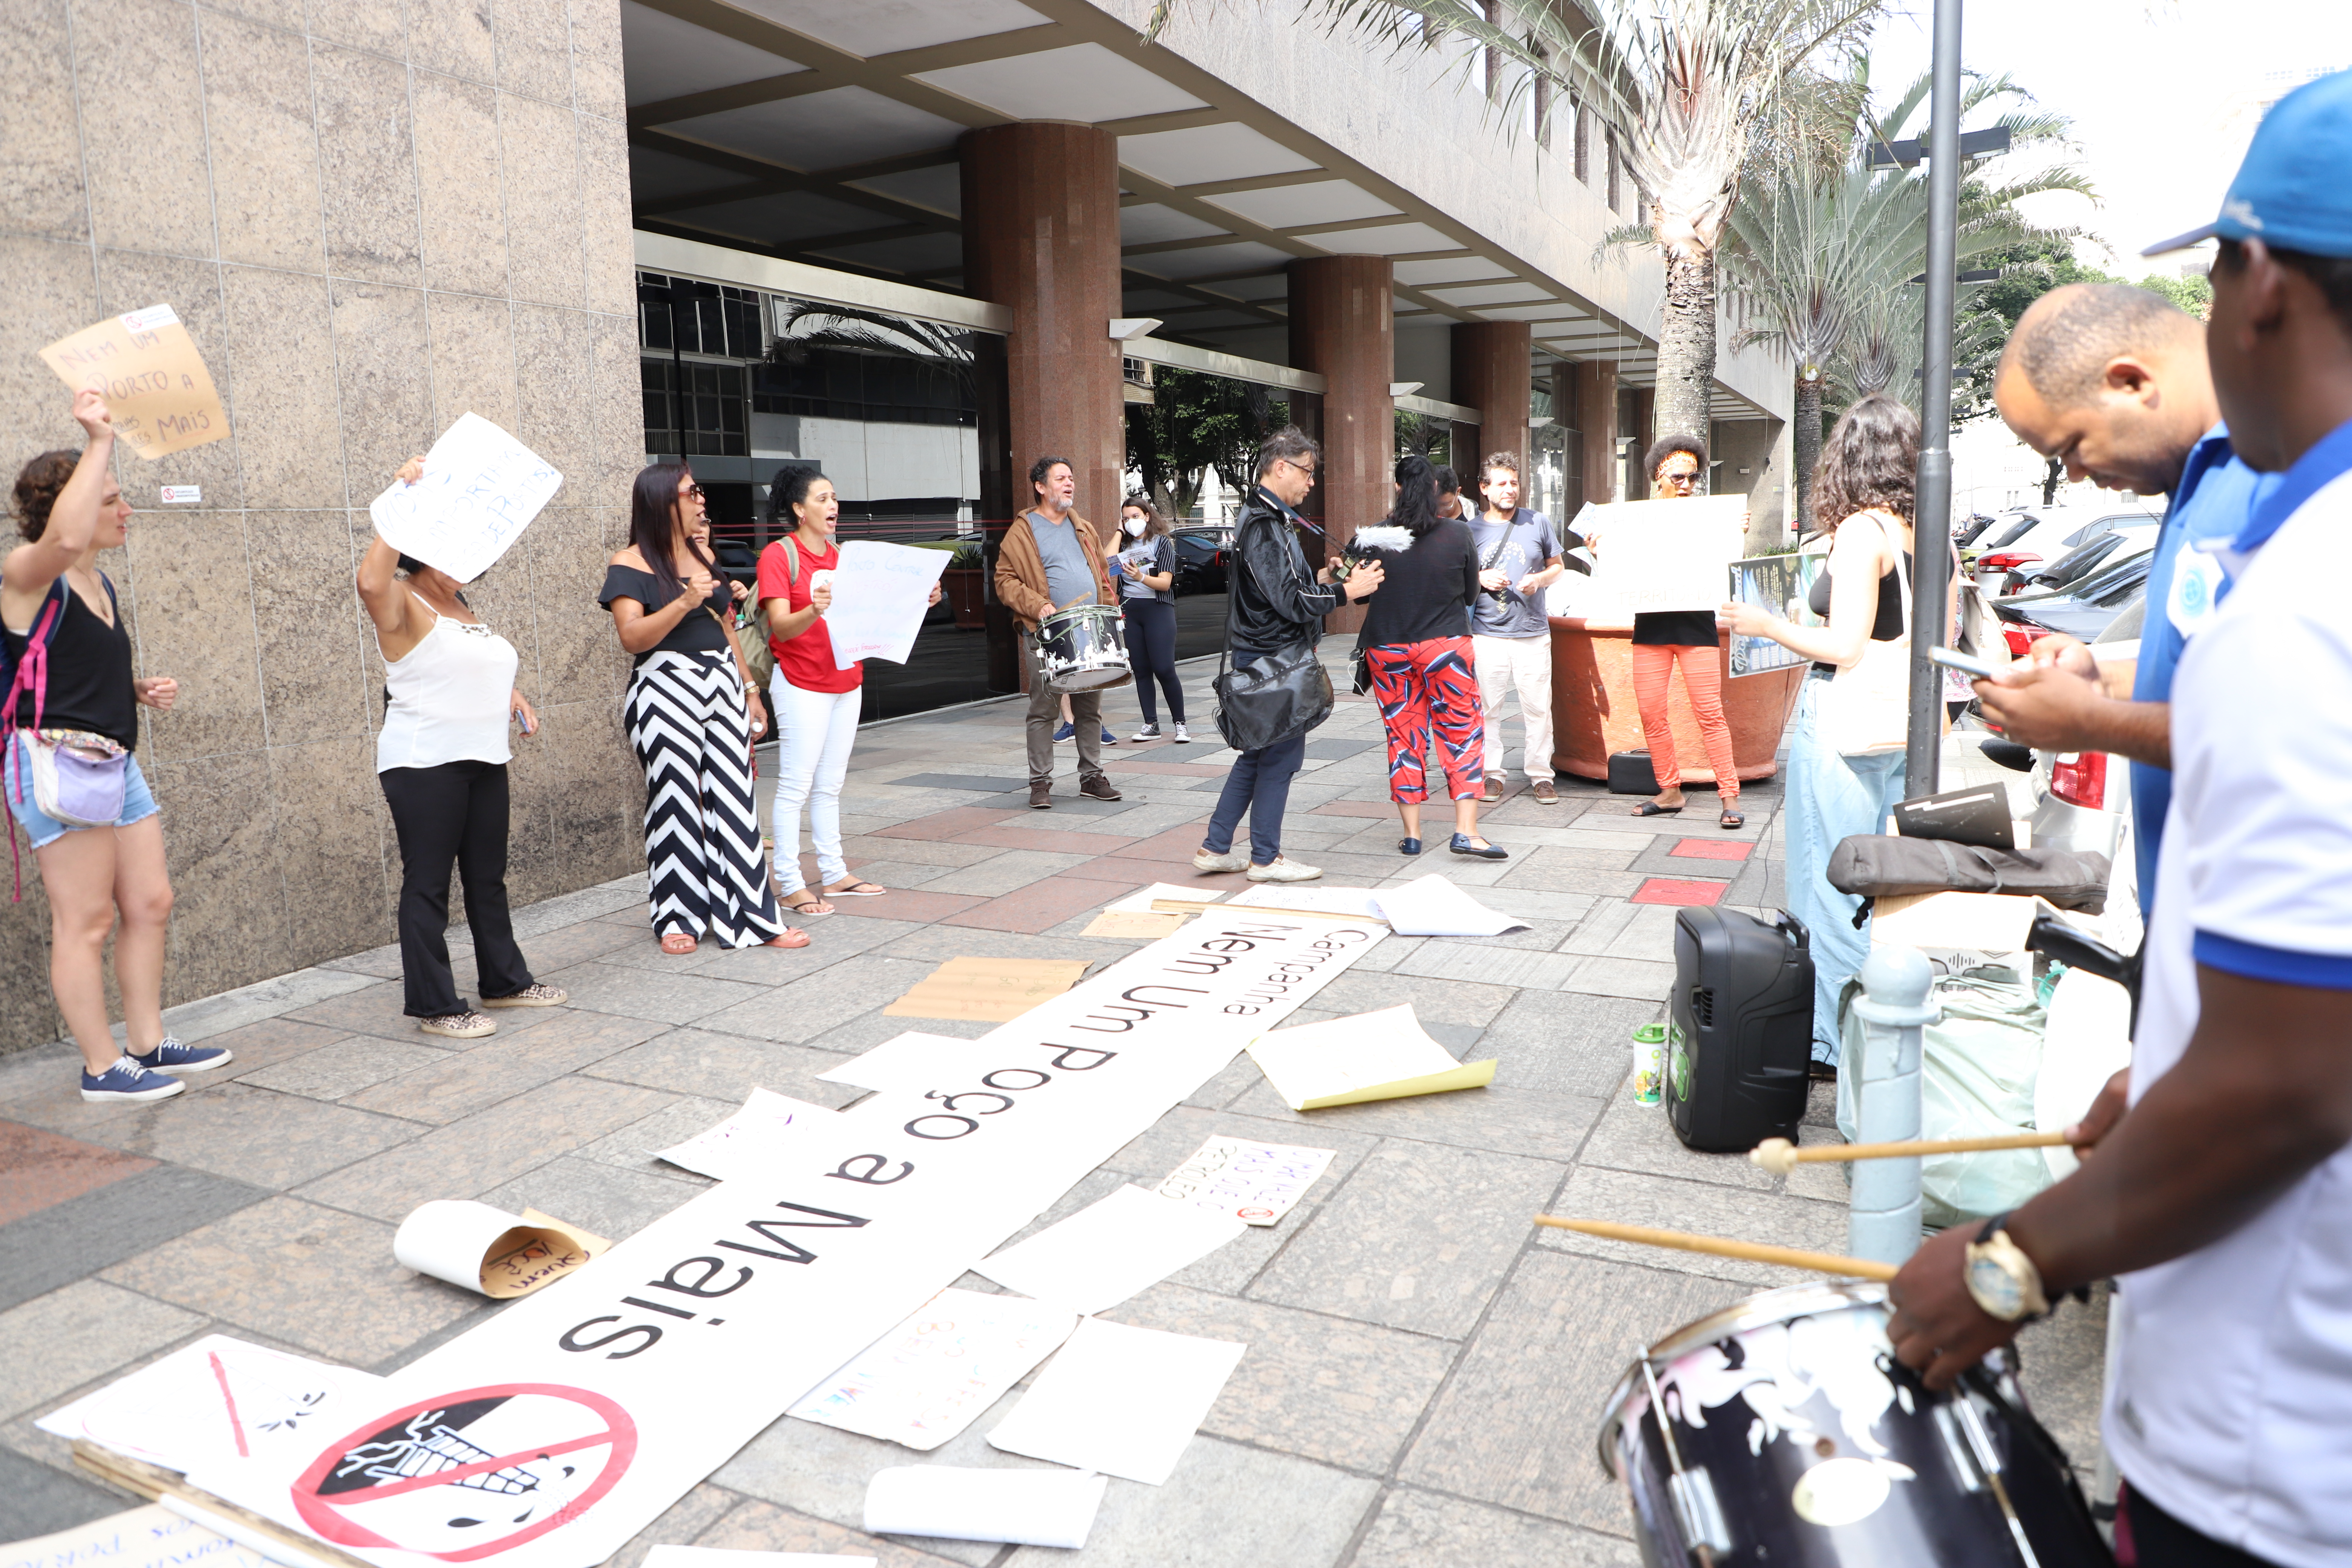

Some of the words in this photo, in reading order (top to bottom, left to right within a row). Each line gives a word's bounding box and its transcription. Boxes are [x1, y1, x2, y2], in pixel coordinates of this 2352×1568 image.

[59, 340, 119, 370] NEM
[130, 331, 160, 350] UM
[87, 371, 168, 401] PORTO
[182, 374, 194, 390] A
[482, 522, 507, 545] DE
[885, 551, 924, 576] CENTRAL
[1163, 922, 1303, 975] Nem
[1223, 929, 1369, 1015] Campanha
[1069, 985, 1211, 1033] Um
[903, 1042, 1119, 1140] Poço
[823, 1153, 915, 1185] a
[1160, 1145, 1237, 1199] PETRÓLEO
[1234, 1147, 1277, 1173] MAIS
[1273, 1160, 1315, 1179] MAR
[1210, 1177, 1251, 1197] QUE
[1254, 1182, 1302, 1204] VALE
[509, 1250, 590, 1289] Quem
[559, 1201, 873, 1360] Mais
[882, 1321, 957, 1364] BEM
[801, 1360, 884, 1419] VIVER
